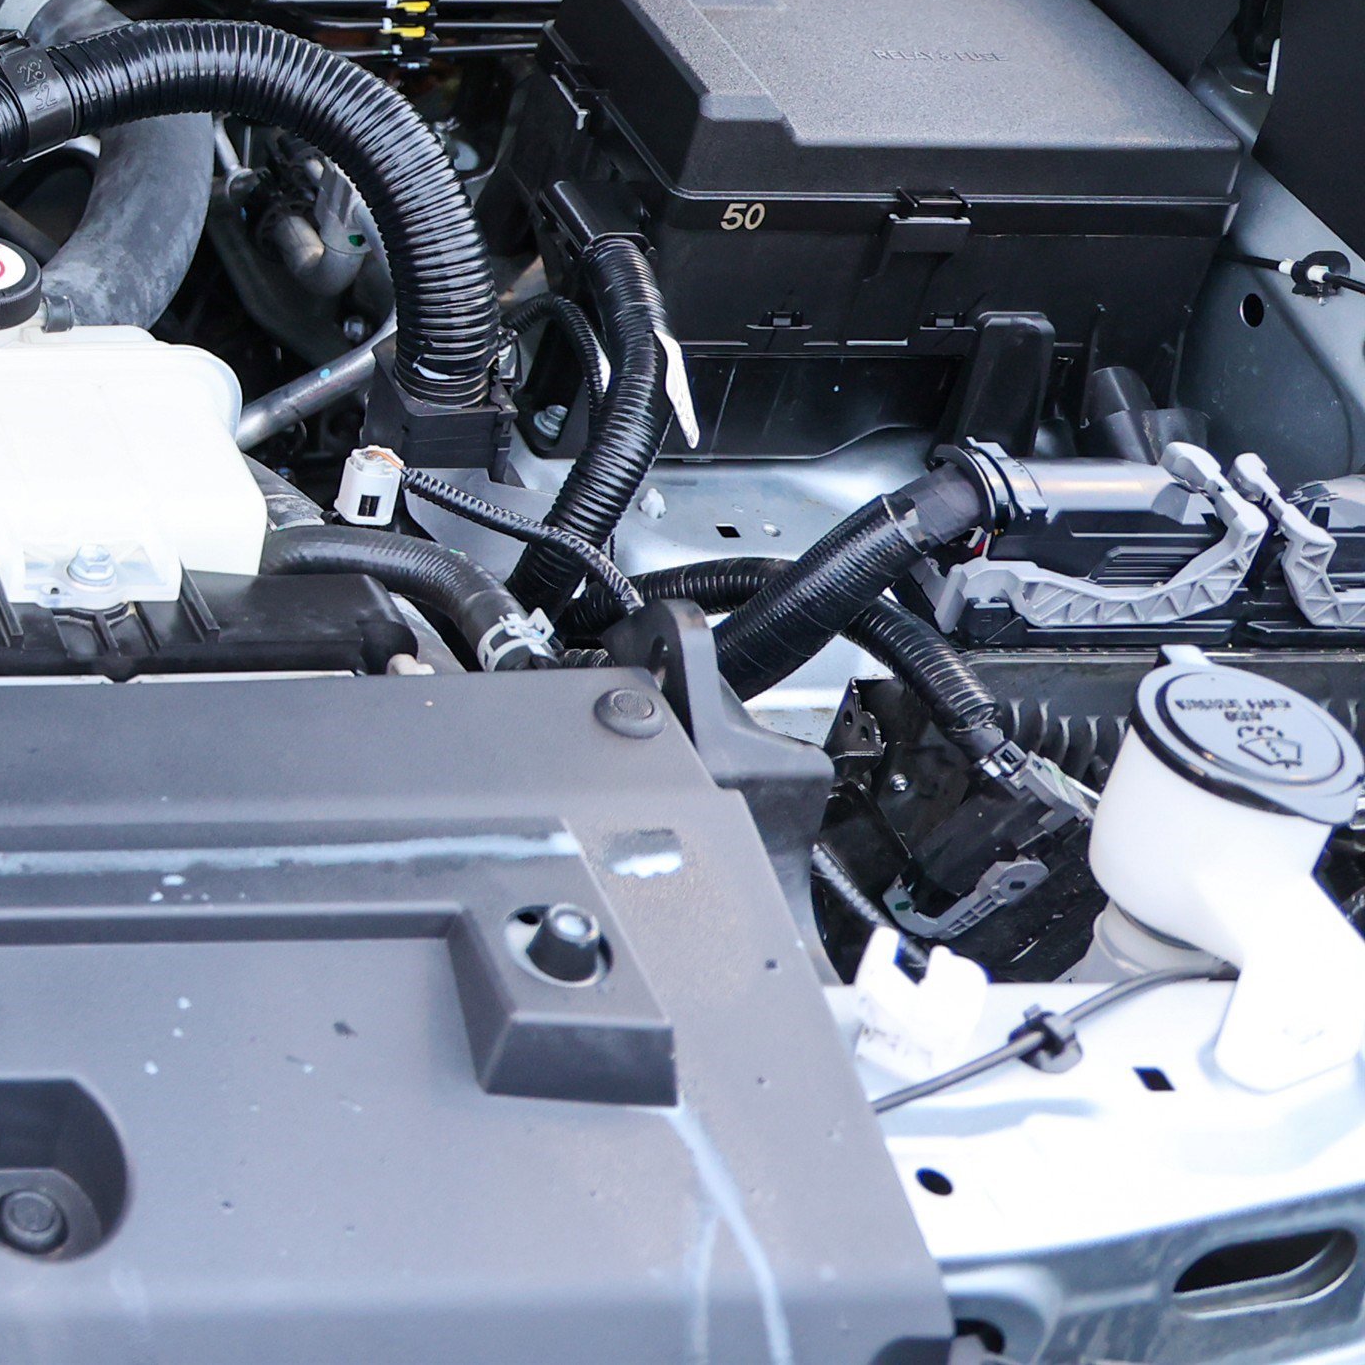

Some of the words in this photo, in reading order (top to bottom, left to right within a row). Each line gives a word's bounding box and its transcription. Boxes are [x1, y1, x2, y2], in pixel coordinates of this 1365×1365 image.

[872, 50, 934, 60] RELAY
[954, 51, 1009, 62] FUSE
[720, 203, 766, 231] 50
